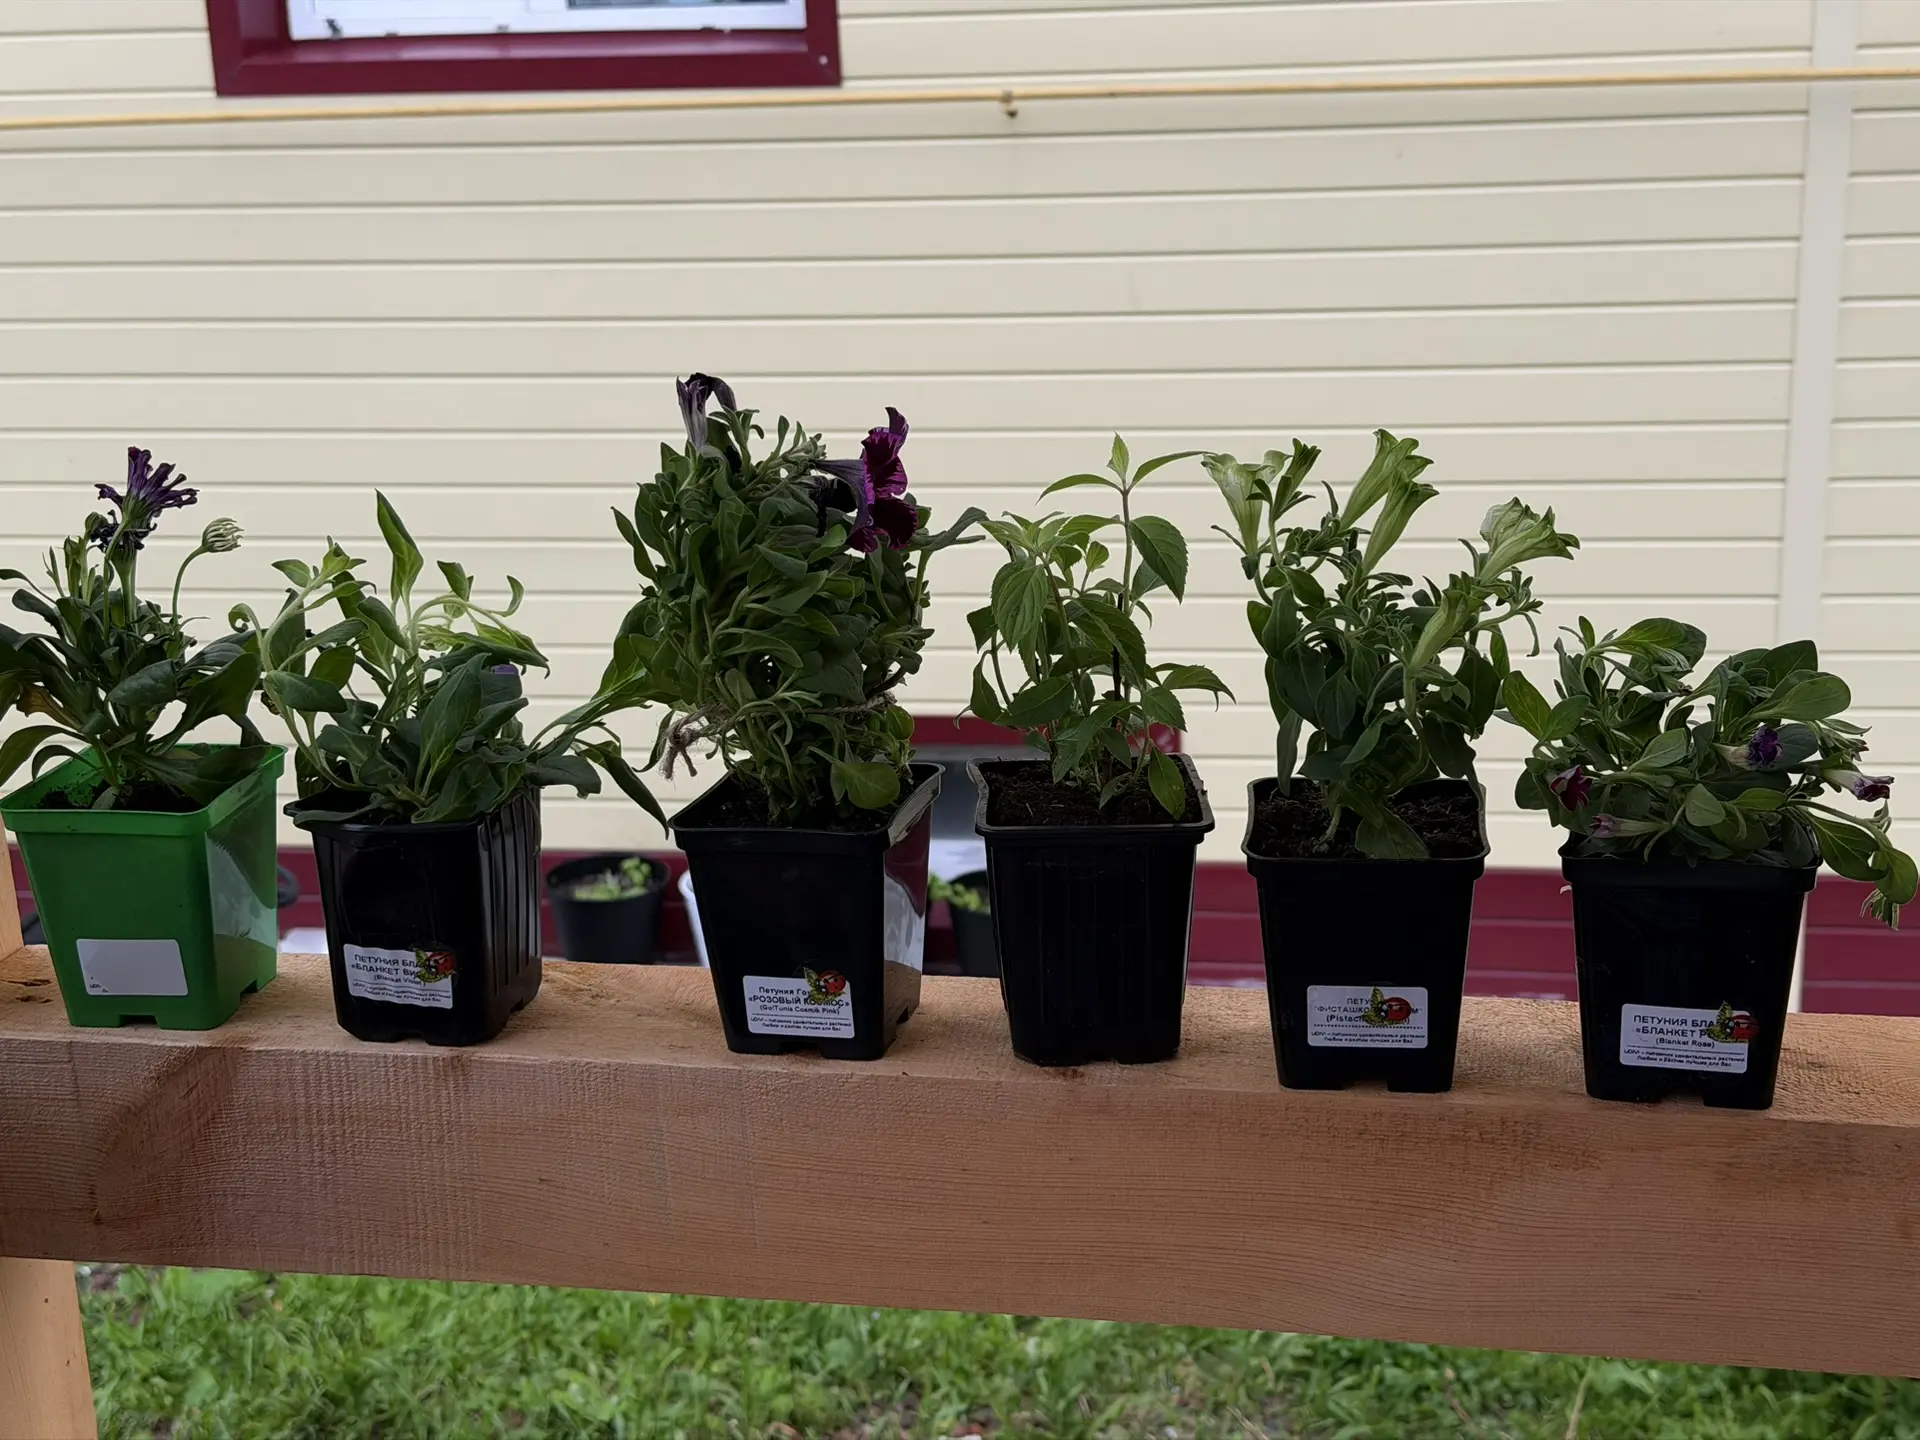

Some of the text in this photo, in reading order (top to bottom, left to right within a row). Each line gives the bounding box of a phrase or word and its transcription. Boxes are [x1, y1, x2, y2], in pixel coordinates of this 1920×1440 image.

[354, 954, 400, 967] ПЕТУНИЯ
[351, 962, 401, 976] «БЛАНКЕТ
[758, 986, 795, 997] Петуния
[748, 994, 802, 1006] «РОЗОВЫЙ
[821, 1007, 841, 1016] Pink)
[1633, 1015, 1687, 1027] ПЕТУНИЯ
[1635, 1026, 1696, 1038] «БЛАНКЕТ
[1655, 1038, 1716, 1049] (Blanket Rose)
